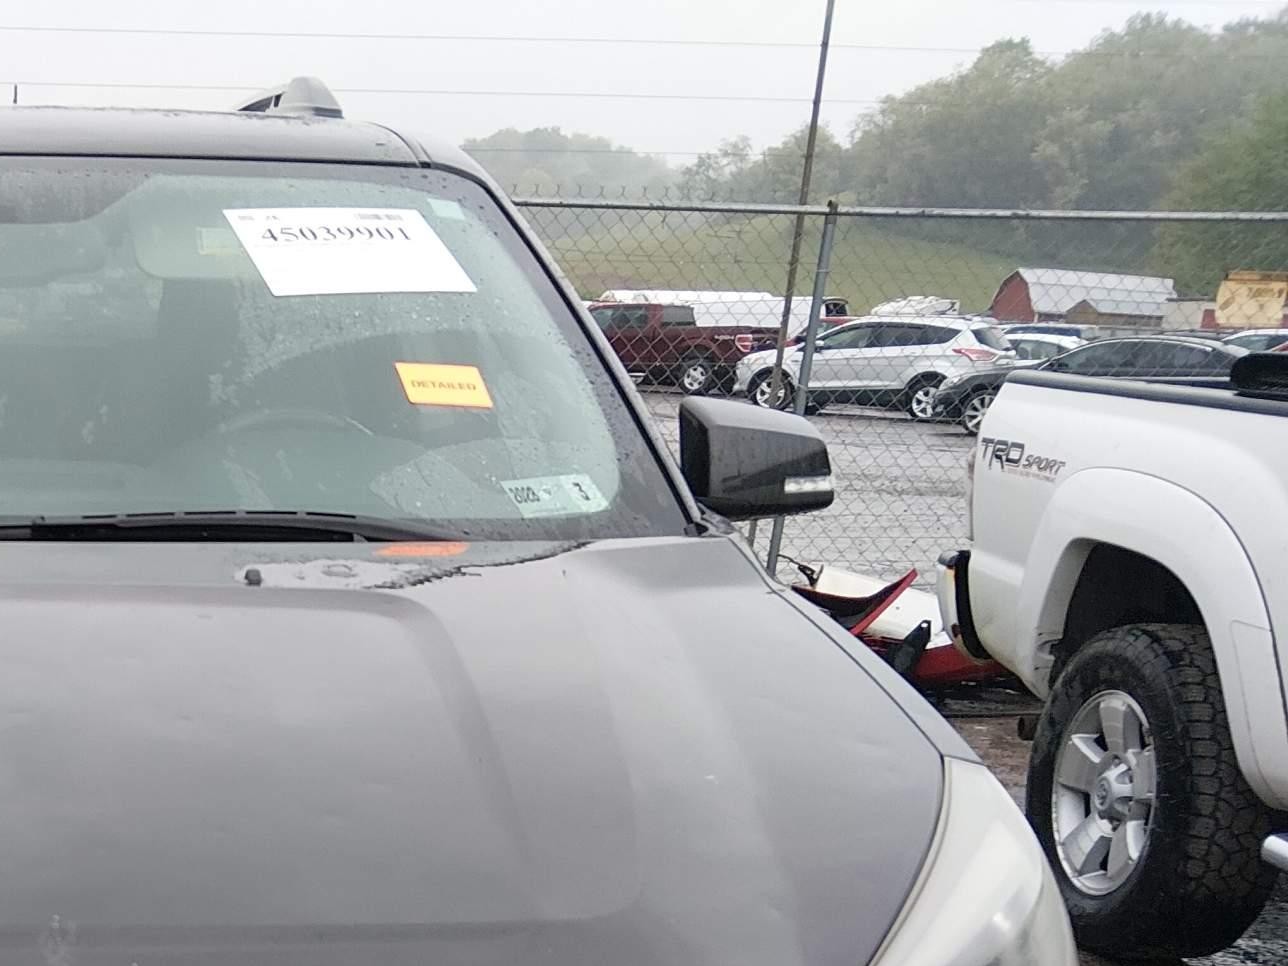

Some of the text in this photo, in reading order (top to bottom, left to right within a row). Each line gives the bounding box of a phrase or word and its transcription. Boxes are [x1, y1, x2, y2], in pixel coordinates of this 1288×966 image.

[261, 221, 412, 242] 45039901
[411, 379, 477, 391] DETAILED
[981, 436, 1025, 472] TRD
[1022, 454, 1066, 475] SPORT
